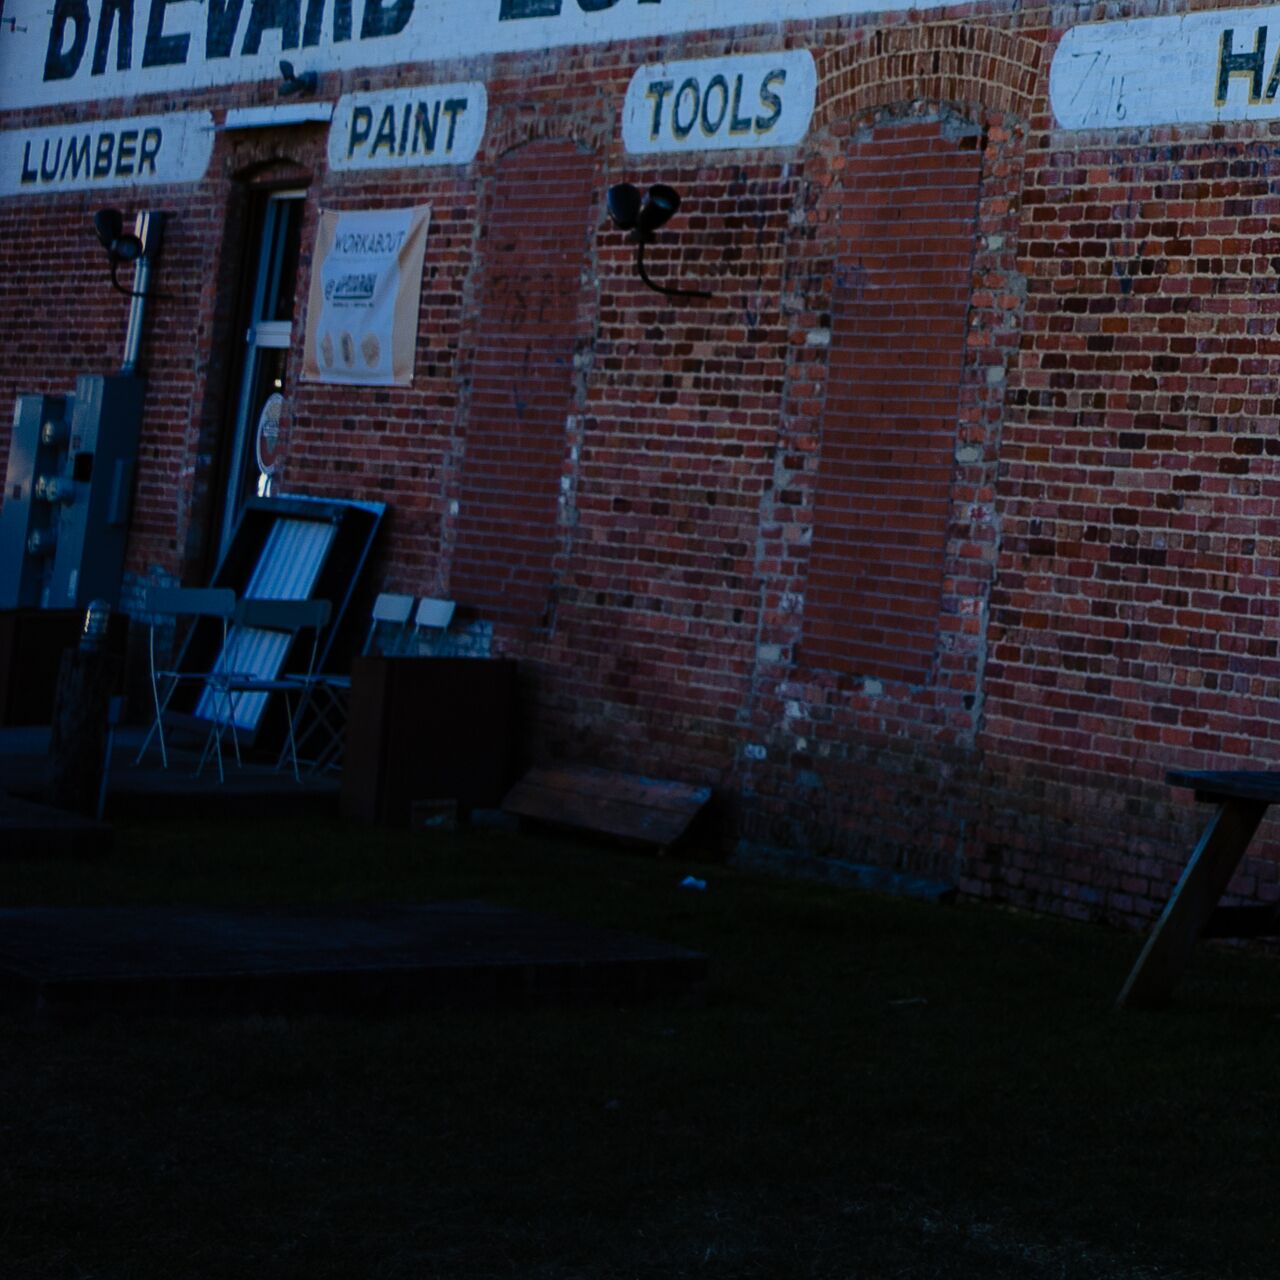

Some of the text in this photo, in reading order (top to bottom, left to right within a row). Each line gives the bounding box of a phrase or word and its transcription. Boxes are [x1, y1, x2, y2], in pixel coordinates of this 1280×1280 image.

[346, 97, 469, 160] PAINT
[646, 67, 787, 141] TOOLS
[20, 126, 163, 184] LUMBER
[334, 230, 406, 254] WORKABOUT
